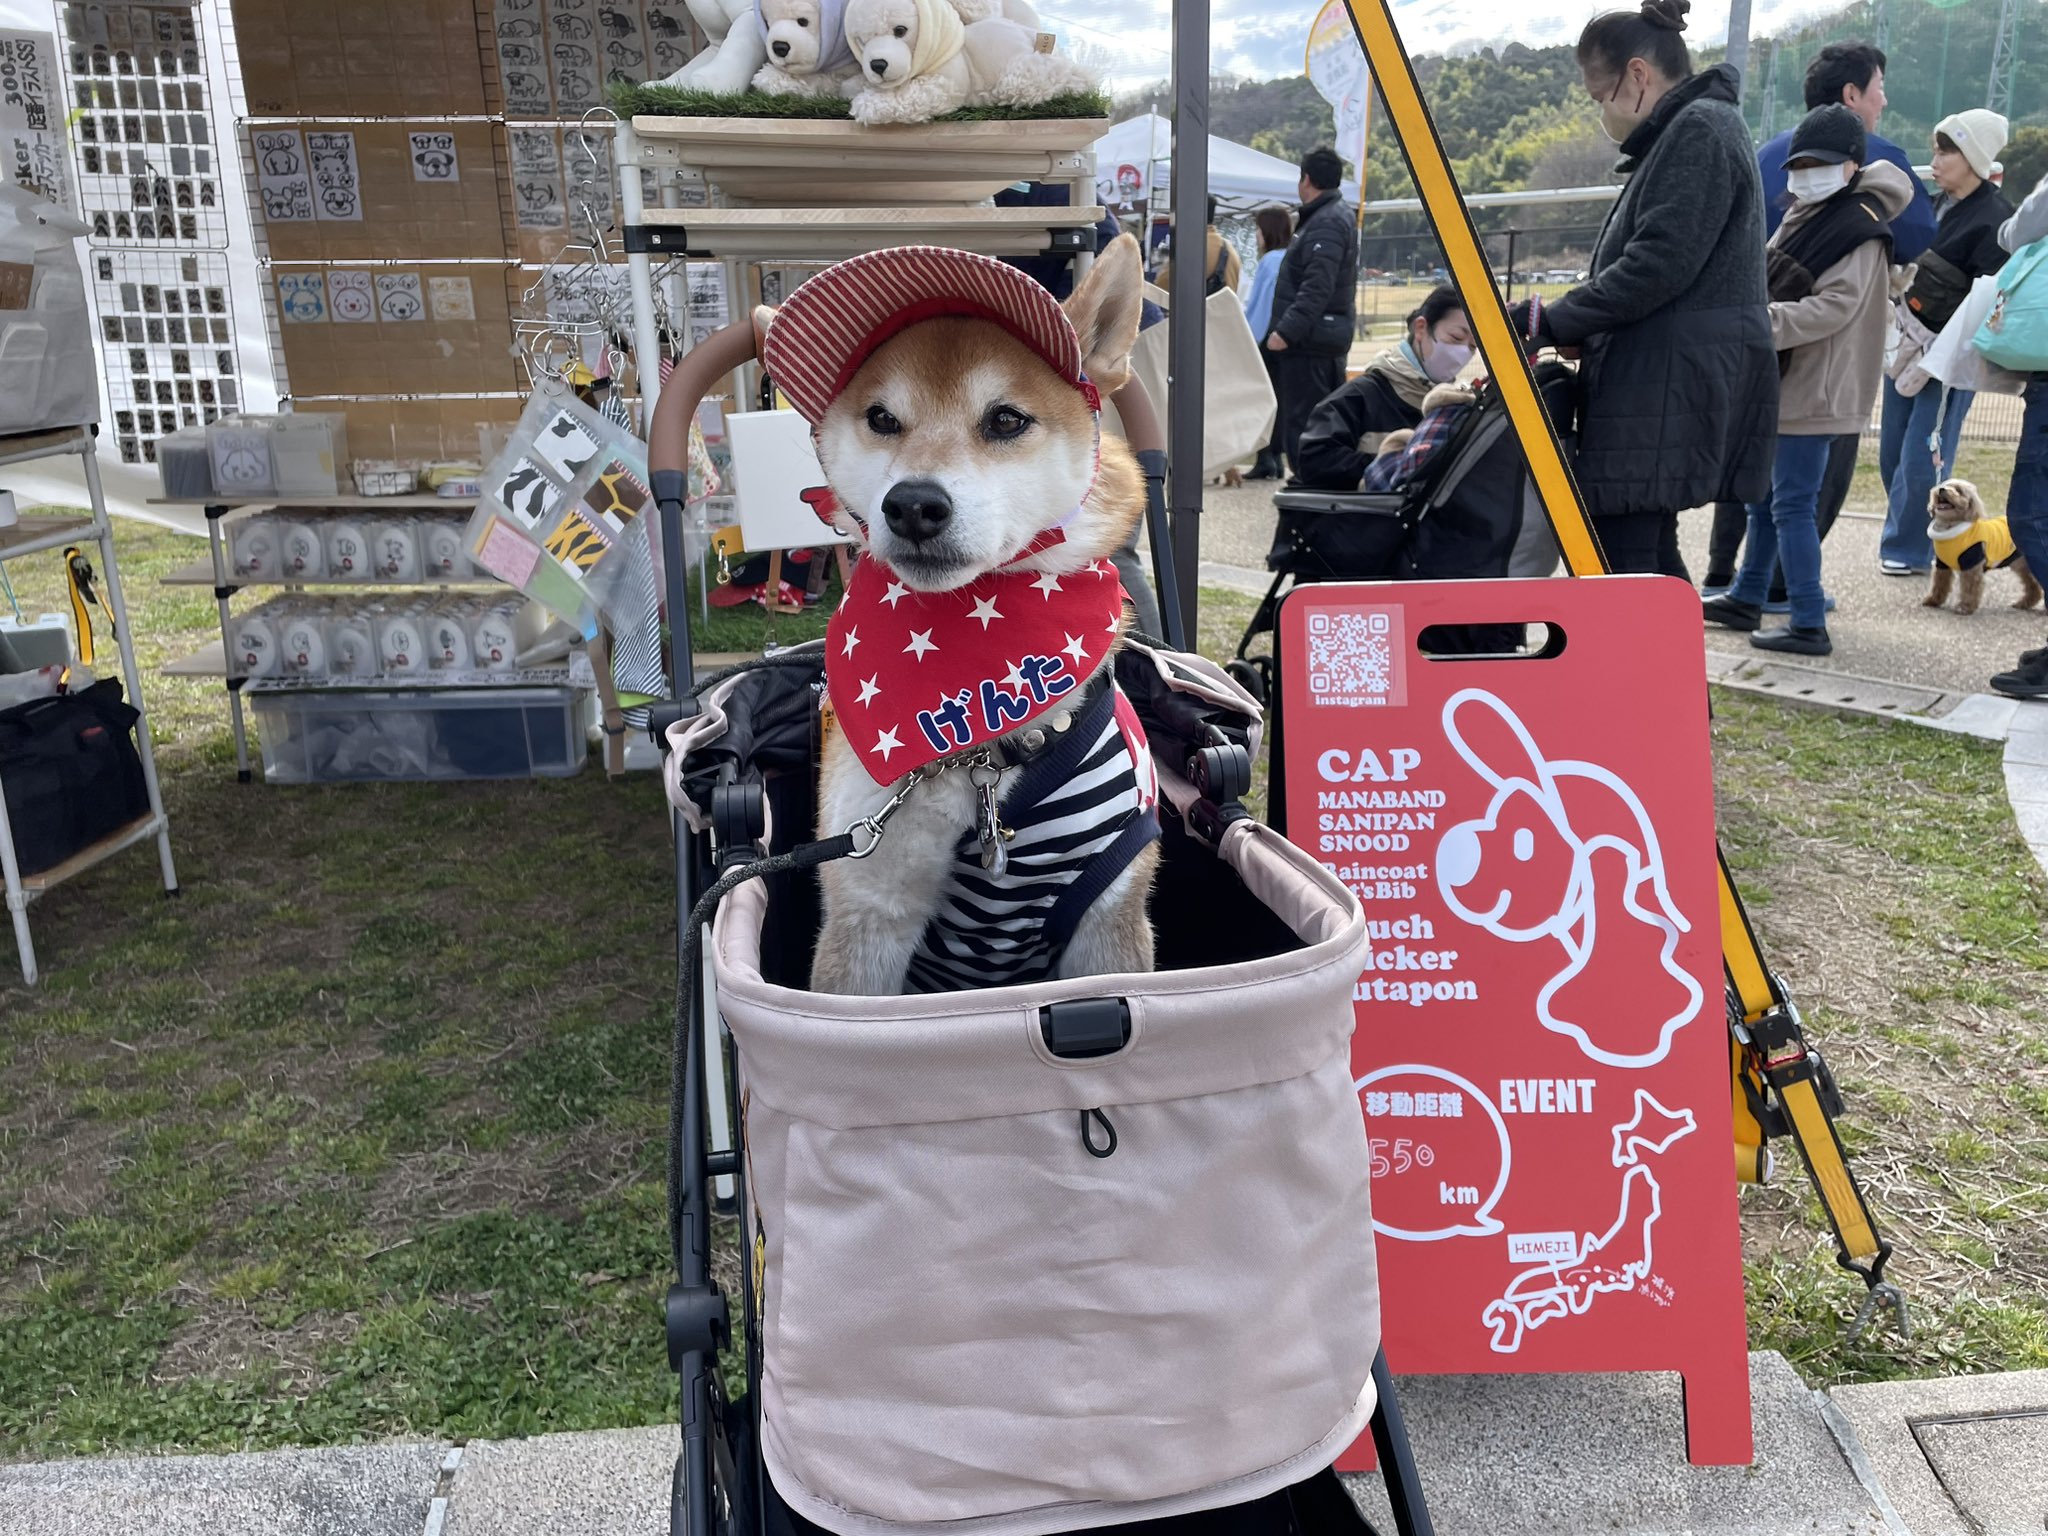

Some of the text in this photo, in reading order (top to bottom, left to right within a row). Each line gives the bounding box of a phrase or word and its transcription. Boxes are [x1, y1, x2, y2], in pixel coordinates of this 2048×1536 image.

[916, 654, 1076, 754] げんた
[1317, 748, 1421, 783] CAP
[1317, 790, 1447, 809] MANABAND
[1318, 812, 1436, 832] SANIPAN
[1319, 833, 1410, 852] SNOOD
[1352, 978, 1478, 1007] utapon
[1366, 1092, 1464, 1117] 移動距離
[1499, 1079, 1597, 1114] EVENT
[1439, 1181, 1479, 1205] km
[1514, 1241, 1571, 1255] HIMEJI
